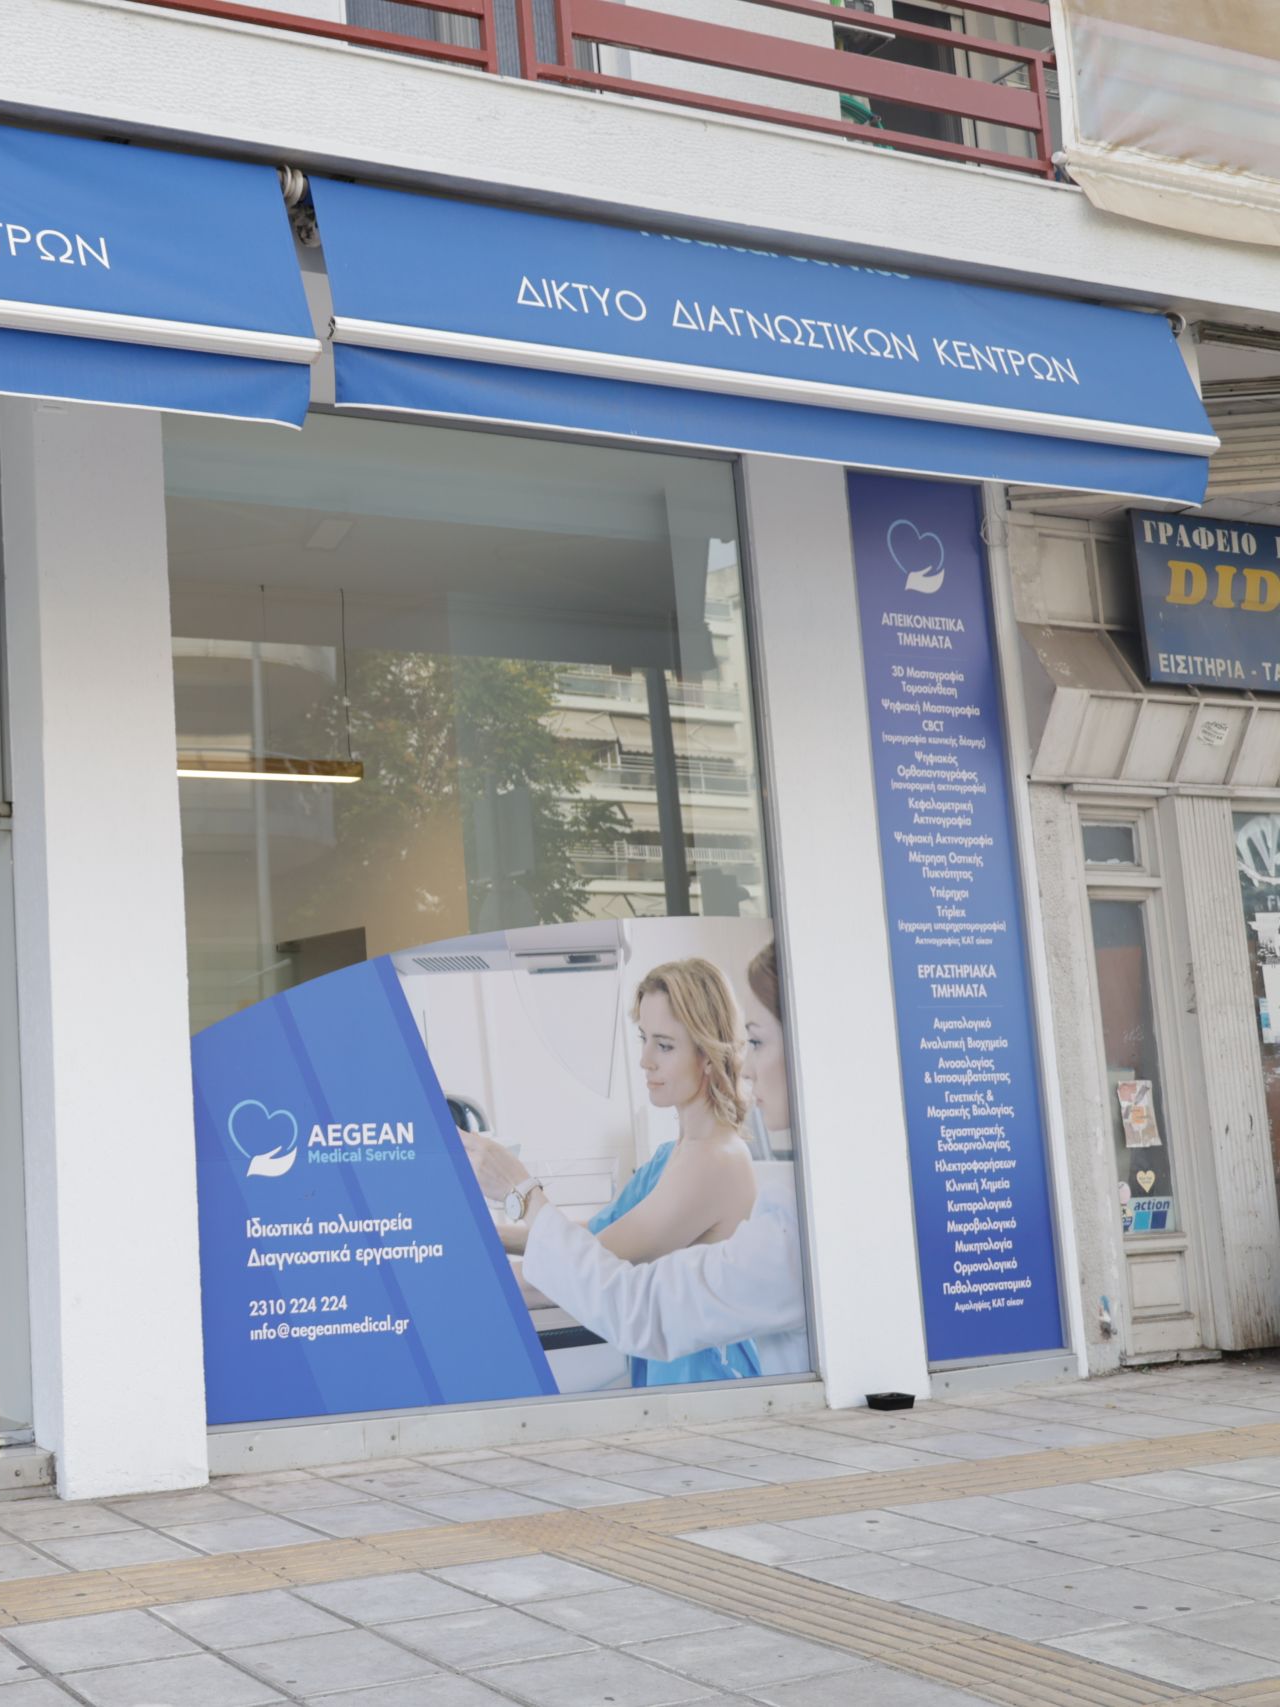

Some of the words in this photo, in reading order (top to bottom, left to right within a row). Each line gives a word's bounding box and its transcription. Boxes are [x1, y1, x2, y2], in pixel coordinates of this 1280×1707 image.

[518, 276, 648, 322] ΔΙΚΤΥΟ
[672, 299, 920, 362] ΔΙΑΓΝΩΣΤΙΚΩΝ
[933, 337, 1081, 385] ΚΕΝΤΡΩΝ
[1142, 520, 1257, 556] ΓΡΑΦΕΙΟ
[881, 612, 965, 632] ΑΠΕΙΚΟΝΙΣΤΙΚΑ
[897, 632, 952, 649] ΤΜΗΜΑΤΑ
[892, 666, 904, 677] 3D
[1158, 653, 1245, 679] ΕΙΣΙΤΗΡΙΑ
[922, 720, 944, 732] CBCT
[936, 905, 966, 920] Triplex
[917, 964, 996, 978] ΕΡΓΑΣΤΗΡΙΑΚΑ
[931, 984, 987, 998] ΤΜΗΜΑΤΑ
[924, 1072, 932, 1084] &
[987, 1090, 994, 1101] &
[308, 1122, 414, 1147] AEGEAN
[308, 1148, 362, 1164] Medical
[366, 1148, 415, 1162] Service
[1134, 1199, 1170, 1211] action
[246, 1218, 313, 1238] Ιδιωτικά
[318, 1213, 412, 1237] πολυιατρεία
[247, 1244, 350, 1271] Διαγνωστικά
[356, 1240, 443, 1267] εργαστήρια
[249, 1299, 286, 1316] 2310
[290, 1297, 317, 1314] 224
[321, 1295, 347, 1312] 224
